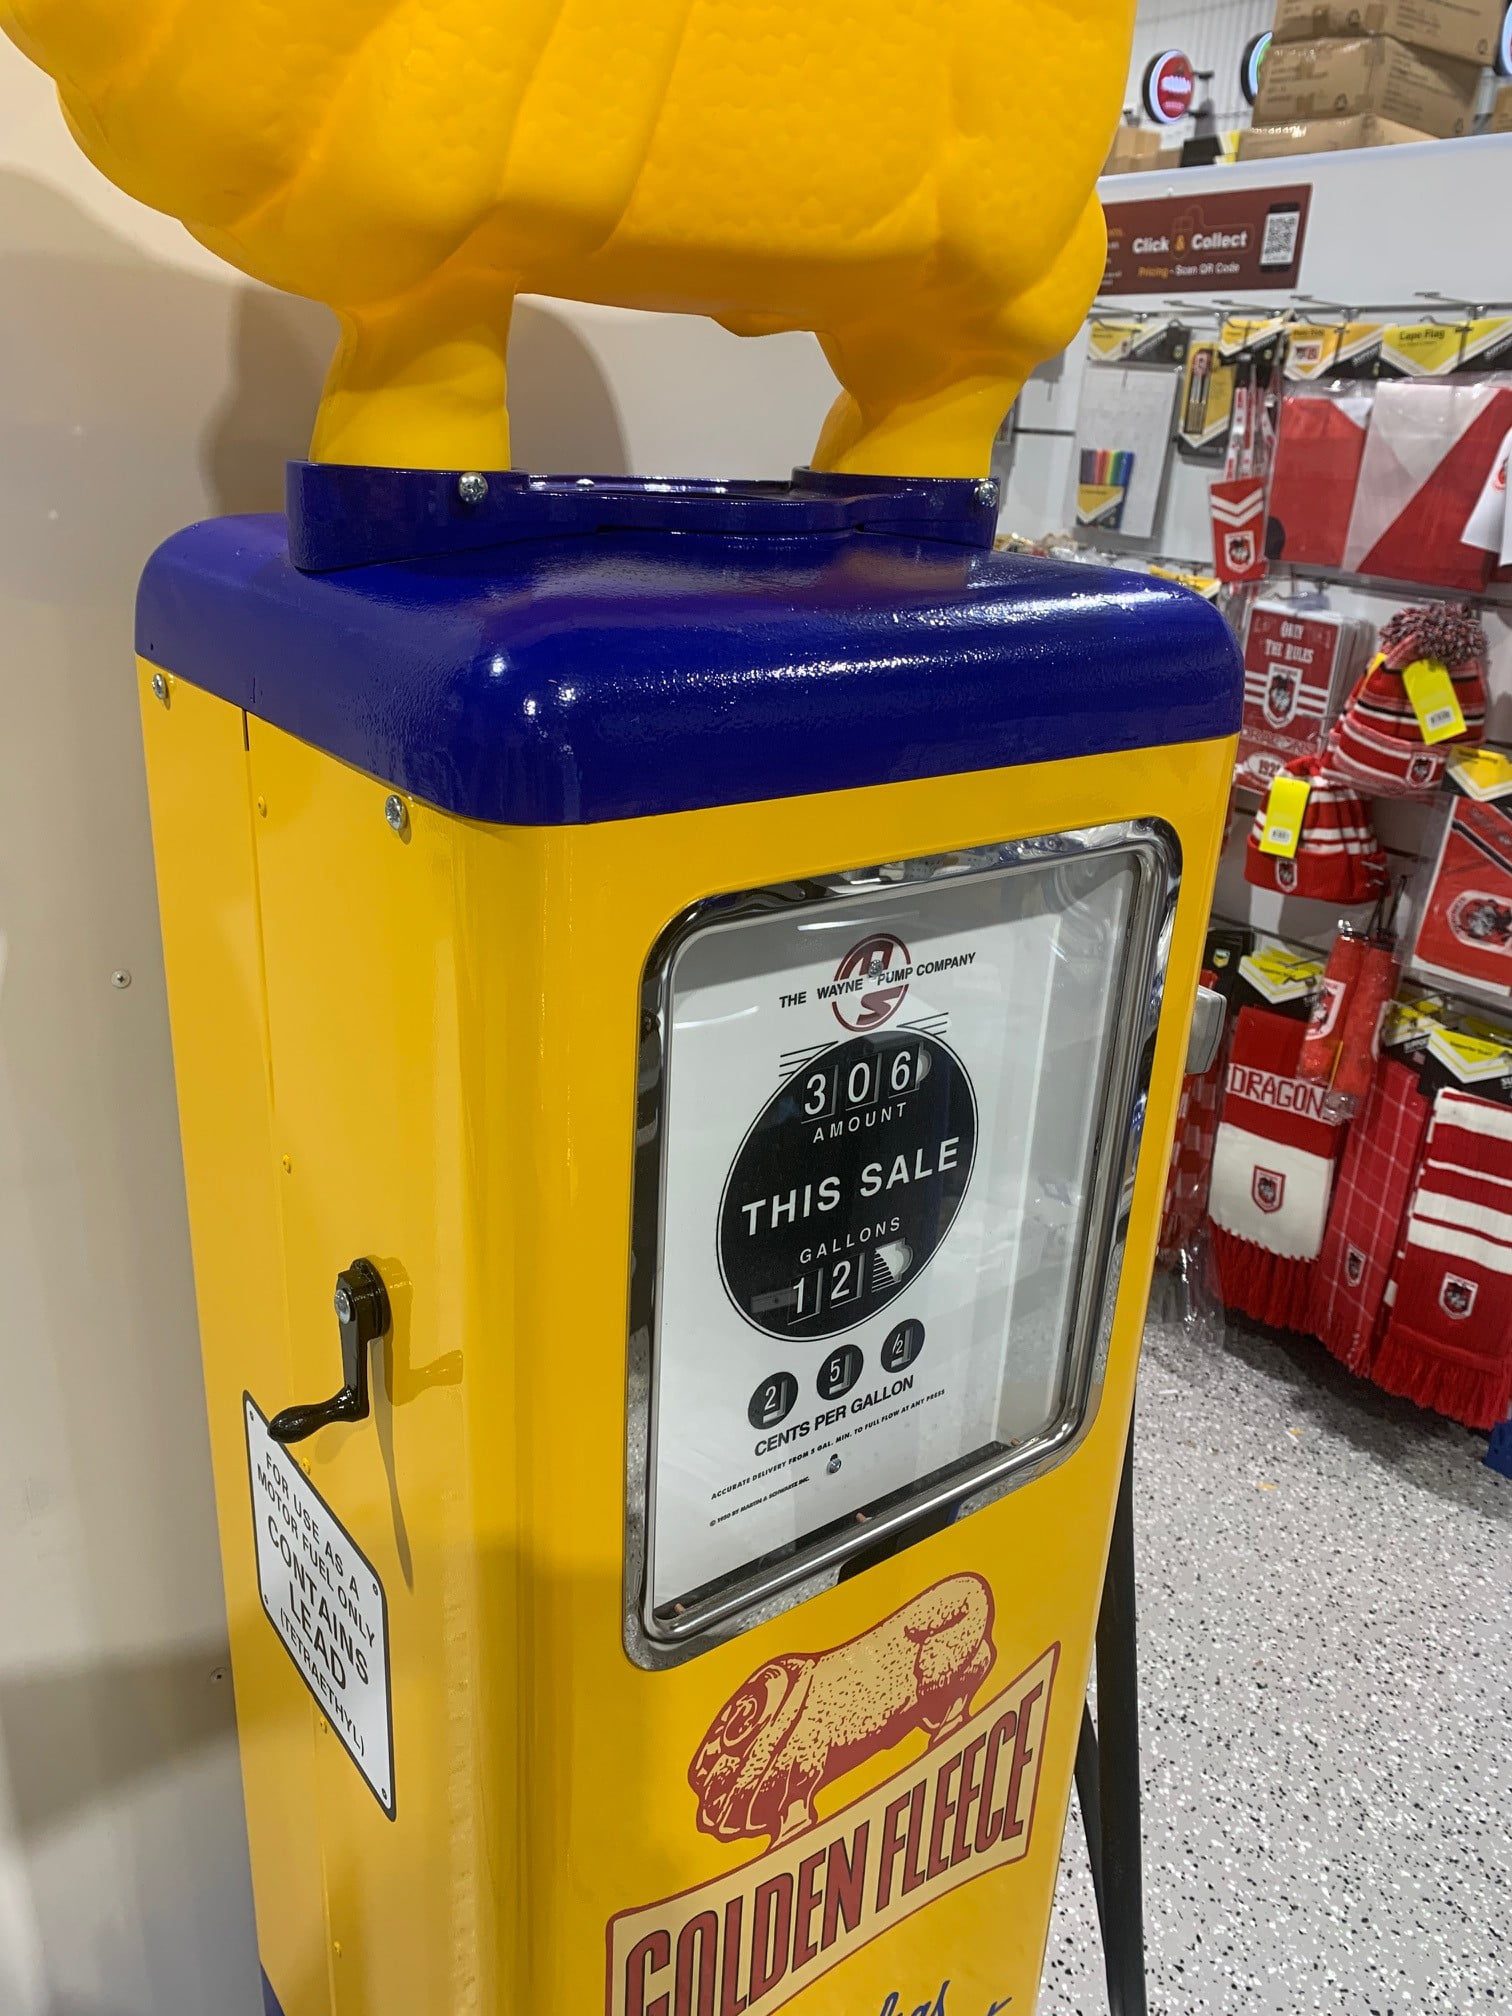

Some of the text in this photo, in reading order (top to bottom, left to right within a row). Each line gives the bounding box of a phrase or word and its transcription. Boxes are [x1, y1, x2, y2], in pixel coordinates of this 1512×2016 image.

[1132, 236, 1170, 254] Click
[1175, 234, 1185, 252] &
[1191, 230, 1248, 251] Collect
[1137, 266, 1169, 280] Pricing
[1174, 264, 1198, 276] Scan
[1199, 262, 1214, 276] QR
[1215, 261, 1240, 275] Code
[1399, 328, 1445, 341] Cape Flag
[1264, 638, 1284, 657] THE
[779, 952, 976, 1009] THE WAYNE PUMP COMPANY
[813, 1102, 907, 1144] AMOUNT
[741, 1136, 960, 1236] THIS SALE
[800, 1216, 900, 1264] GALLONS
[711, 1477, 751, 1500] ACCURATE
[752, 1461, 787, 1481] DELIVERY
[788, 1450, 809, 1465] FROM
[835, 1432, 852, 1443] MIN.
[854, 1426, 863, 1435] TO
[864, 1419, 880, 1431] FULL
[881, 1409, 900, 1422] FLOW
[901, 1405, 910, 1414] AT
[926, 1389, 945, 1402] PRESS
[754, 1375, 914, 1456] CENTS PER GALLON
[257, 1463, 375, 1648] MOTOR FUEL ONLY
[266, 1452, 360, 1601] FOR USE AS A
[268, 1515, 369, 1685] CONTAINS
[289, 1580, 346, 1690] LEAD
[280, 1607, 365, 1757] (TETRAETHYL)
[625, 1680, 1044, 2016] GOLDEN FLEECE
